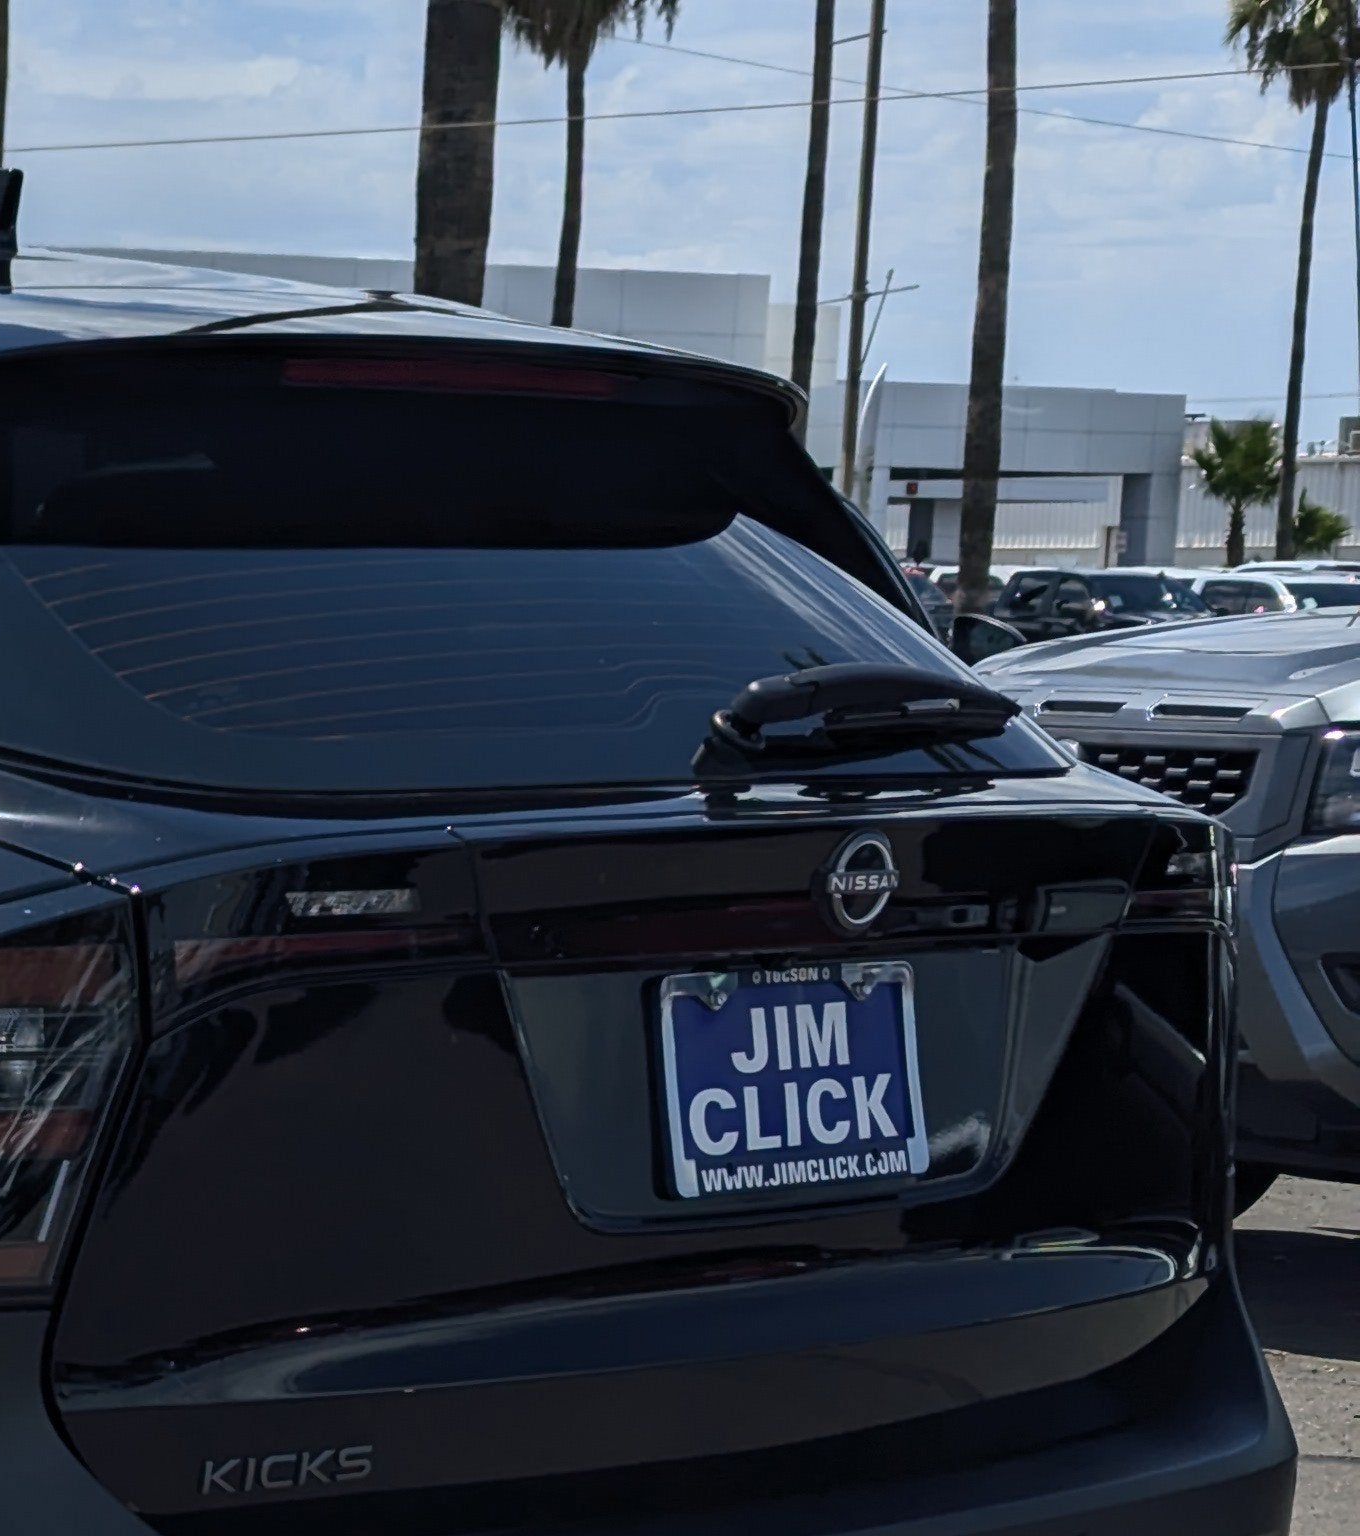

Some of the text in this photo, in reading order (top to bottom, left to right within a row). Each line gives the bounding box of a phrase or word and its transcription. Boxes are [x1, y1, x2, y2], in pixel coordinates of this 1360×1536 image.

[831, 874, 898, 891] NISSAN
[765, 967, 819, 984] TUCSON
[731, 1001, 851, 1074] JIM
[689, 1073, 898, 1155] CLICK
[701, 1150, 908, 1193] WWW.JIMCLICK.COM
[200, 1445, 373, 1495] KICKS
